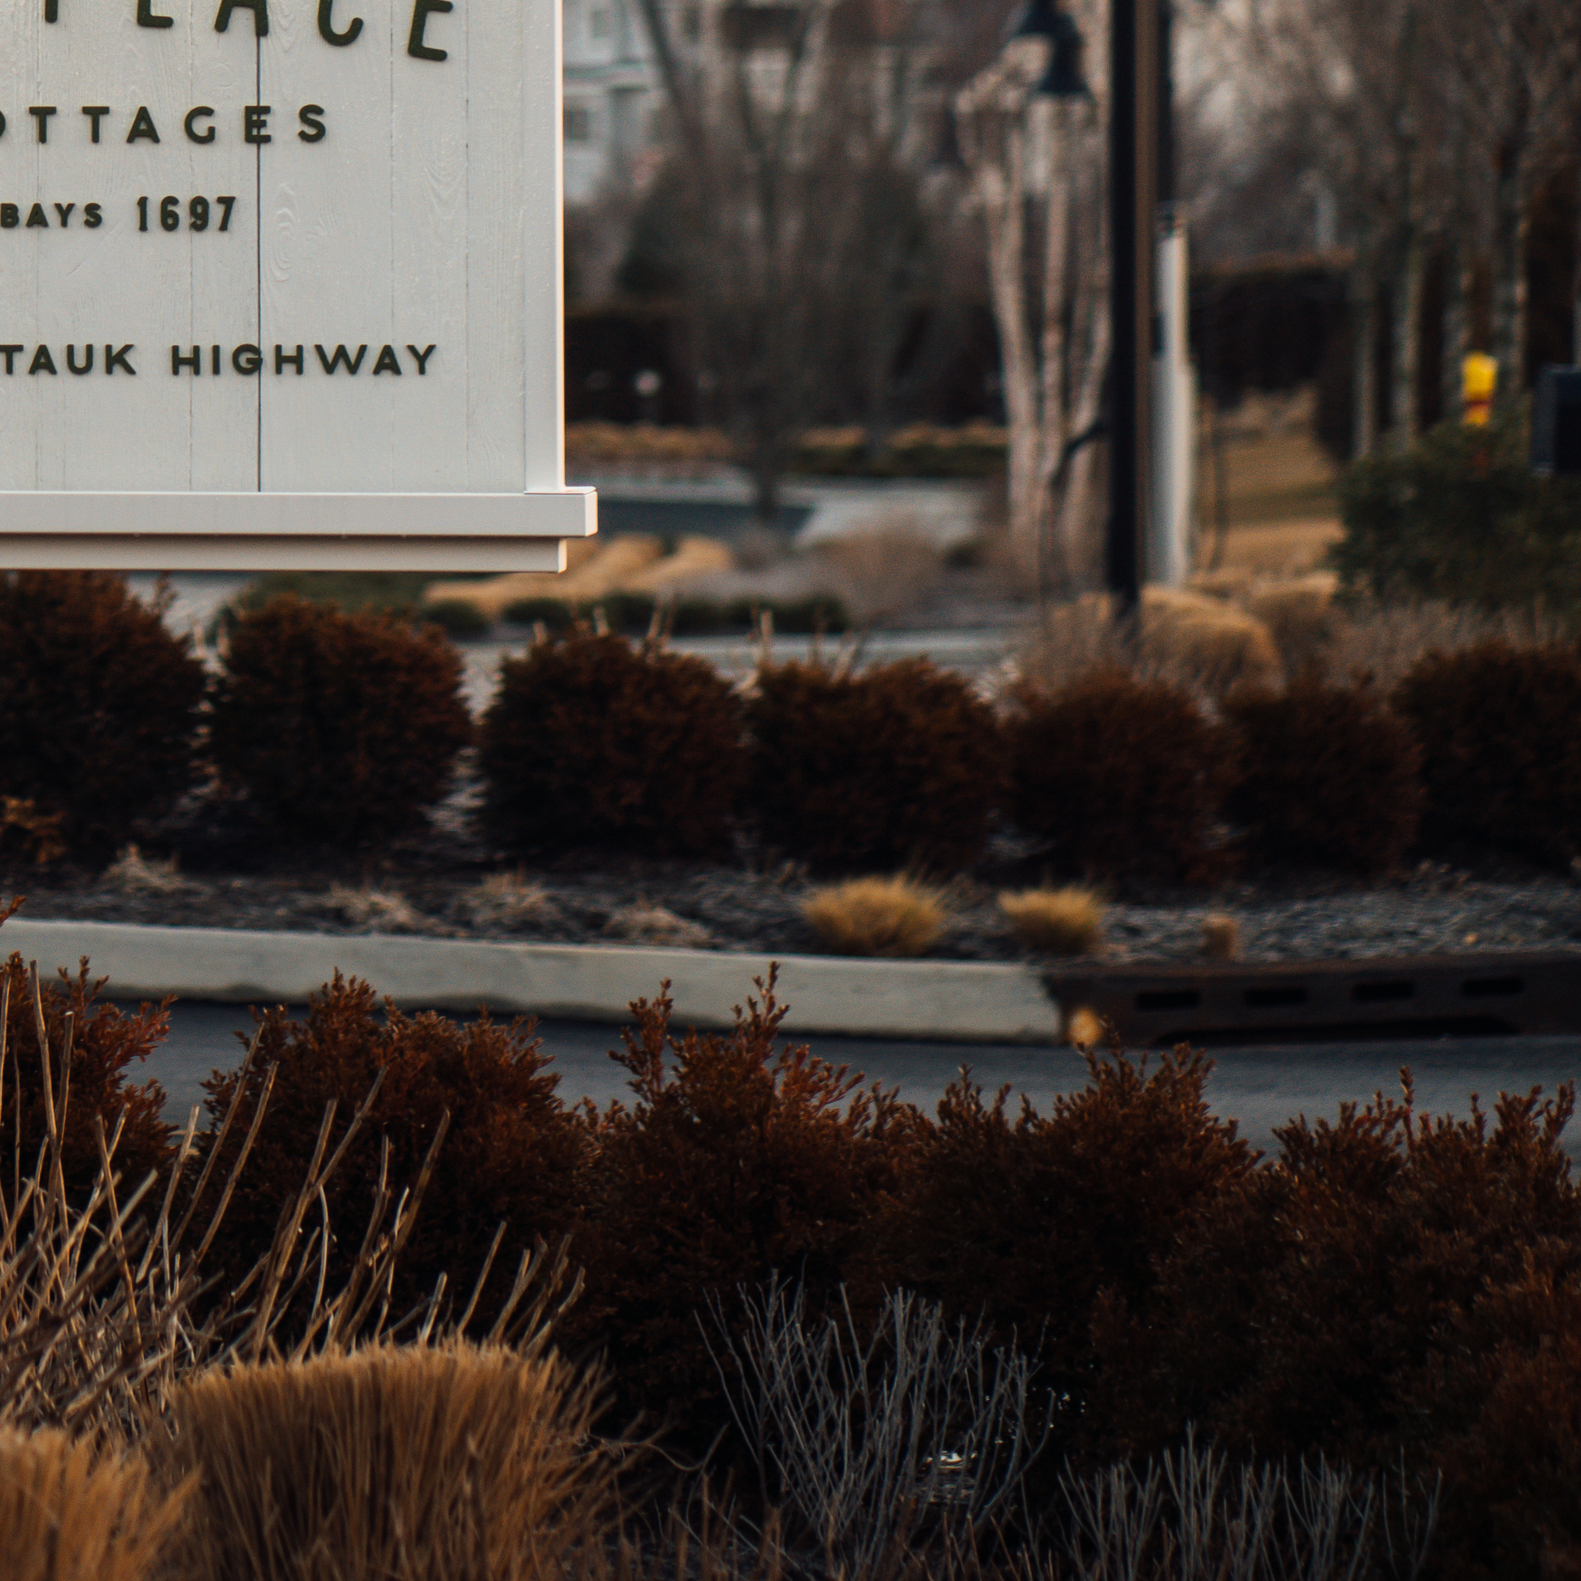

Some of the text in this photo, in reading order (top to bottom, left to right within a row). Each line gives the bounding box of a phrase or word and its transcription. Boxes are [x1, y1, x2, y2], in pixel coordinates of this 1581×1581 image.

[0, 202, 103, 230] BAYS
[136, 195, 236, 232] 1697
[171, 343, 436, 377] HIGHWAY
